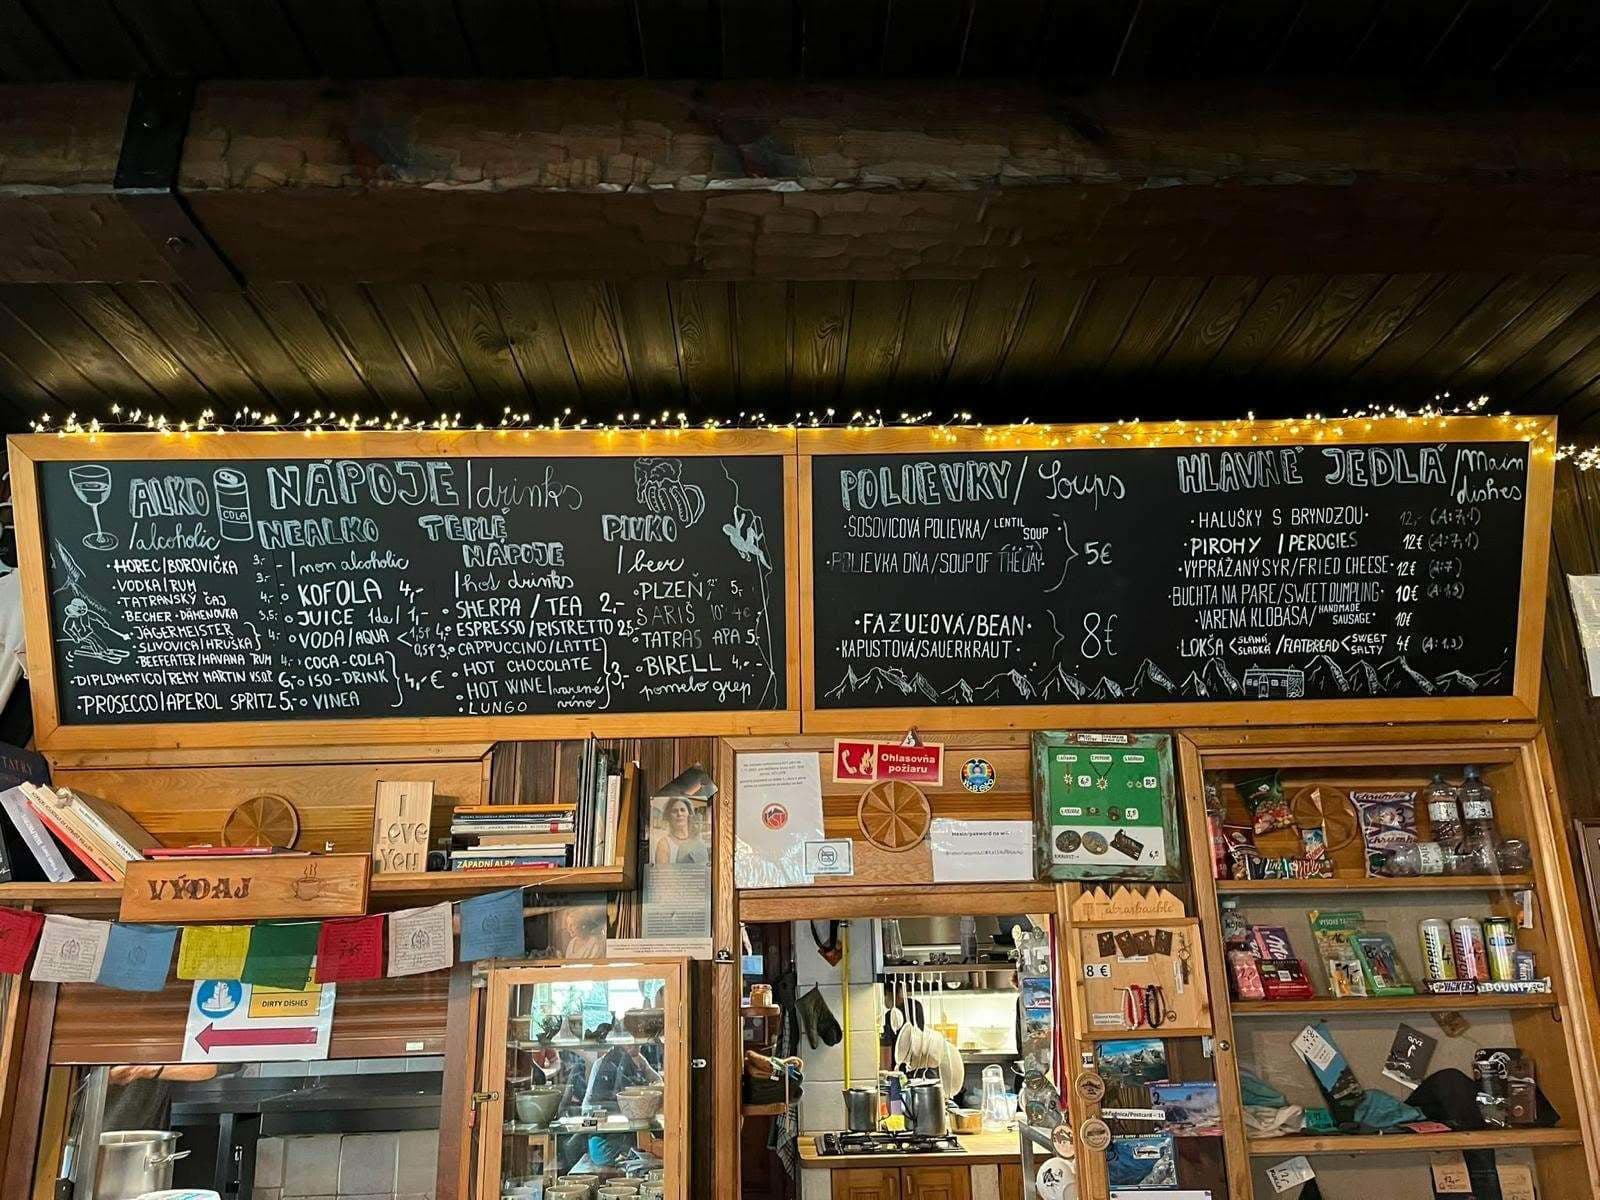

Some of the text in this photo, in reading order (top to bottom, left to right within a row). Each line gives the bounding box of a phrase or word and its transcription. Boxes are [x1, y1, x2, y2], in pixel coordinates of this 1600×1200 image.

[1178, 446, 1304, 494] HLAVNÉ
[128, 476, 210, 519] ALKO
[1456, 478, 1523, 506] dishes
[222, 509, 248, 521] COLA
[418, 508, 508, 541] TEPLÉ
[994, 517, 1025, 529] LENTIL
[1199, 507, 1262, 529] HALUŠKY
[1272, 508, 1282, 526] S
[1291, 505, 1363, 526] BRYNDZOU
[257, 516, 379, 550] NEALKO
[1023, 527, 1049, 541] SOUP
[462, 538, 564, 568] NÁPOJE
[1190, 536, 1262, 557] PIROHY
[1402, 534, 1424, 550] 12€
[976, 552, 993, 573] OF
[1084, 541, 1113, 566] 5€
[1345, 555, 1390, 575] CHEESE
[1396, 561, 1417, 577] 12€
[507, 570, 574, 590] drinks
[118, 592, 197, 608] TATRANSKÝ
[204, 591, 227, 606] ČAJ
[298, 577, 383, 607] KOFOLA
[1173, 584, 1218, 607] BUCHTA
[1221, 584, 1238, 605] NA
[1395, 585, 1419, 603] 10€
[124, 611, 172, 623] BECHER
[297, 608, 354, 626] JUICE
[455, 598, 522, 619] SHERPA
[545, 596, 583, 616] TEA
[1332, 612, 1413, 627] SAUSAGE 10€
[133, 623, 234, 641] JÄGERMEISTER
[712, 627, 742, 646] APA
[1351, 633, 1388, 644] SWEET
[1180, 634, 1224, 658] LOKŠA
[1396, 636, 1412, 652] 4€
[1350, 645, 1383, 656] SALTY
[249, 653, 272, 666] RUM
[463, 656, 592, 677] HOT CHOCOLATE
[642, 653, 722, 678] BIRELL
[202, 669, 246, 684] MARTIN
[466, 681, 500, 700] HOT
[640, 675, 710, 702] pomelo
[230, 692, 277, 711] SPRITZ
[312, 690, 361, 709] VINEA
[469, 701, 528, 715] LUNGO
[881, 753, 936, 764] Ohlasovňa
[888, 764, 928, 774] požiaru
[457, 859, 493, 869] ZÁPADNÍ
[496, 858, 516, 868] ALPY
[147, 873, 252, 901] VÝDAJ
[1086, 964, 1108, 978] 8 €
